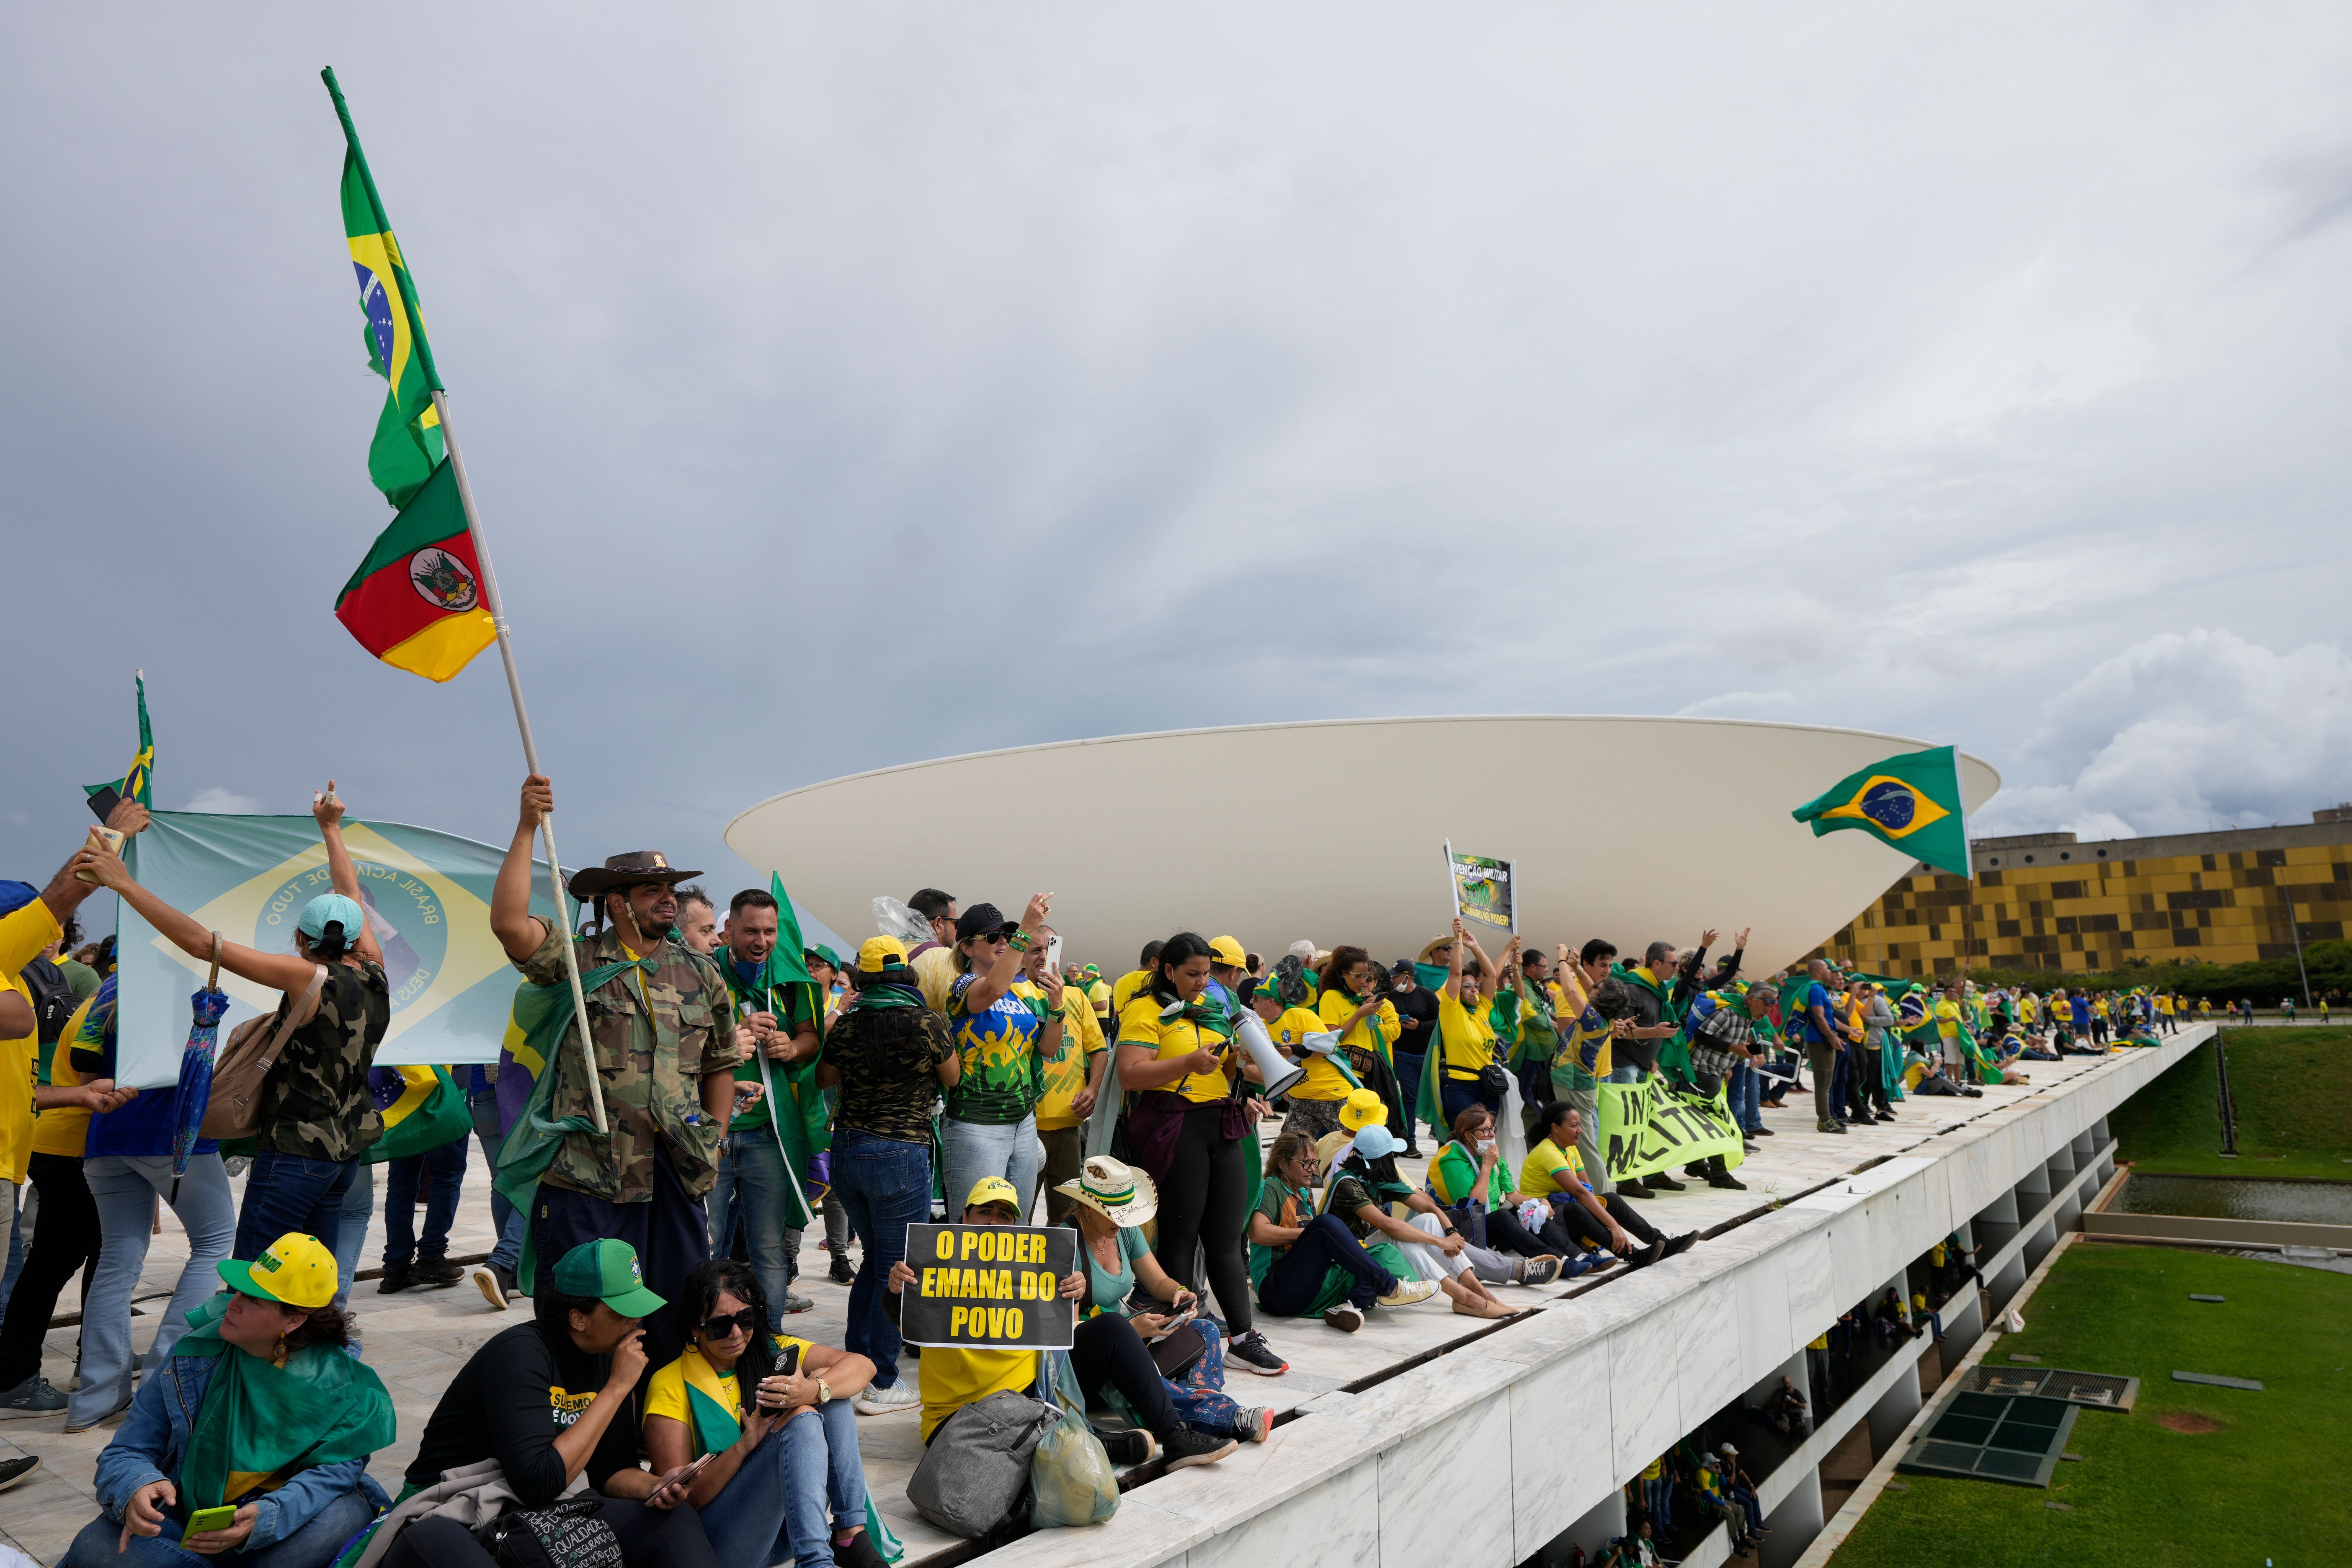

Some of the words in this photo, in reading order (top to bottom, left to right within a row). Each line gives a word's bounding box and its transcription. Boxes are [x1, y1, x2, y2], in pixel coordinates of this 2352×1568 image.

[1483, 867, 1508, 882] MILITAR
[1490, 913, 1509, 926] PODER!
[1061, 1034, 1074, 1048] EIRO
[936, 1230, 954, 1260] O
[961, 1231, 1047, 1264] PODER
[921, 1268, 1013, 1299] EMANA
[1020, 1271, 1056, 1302] DO
[950, 1306, 1024, 1339] POVO
[554, 1393, 591, 1411] SUEMO
[555, 1519, 603, 1554] QUALIDADE
[575, 1532, 609, 1557] SEGURANÇA
